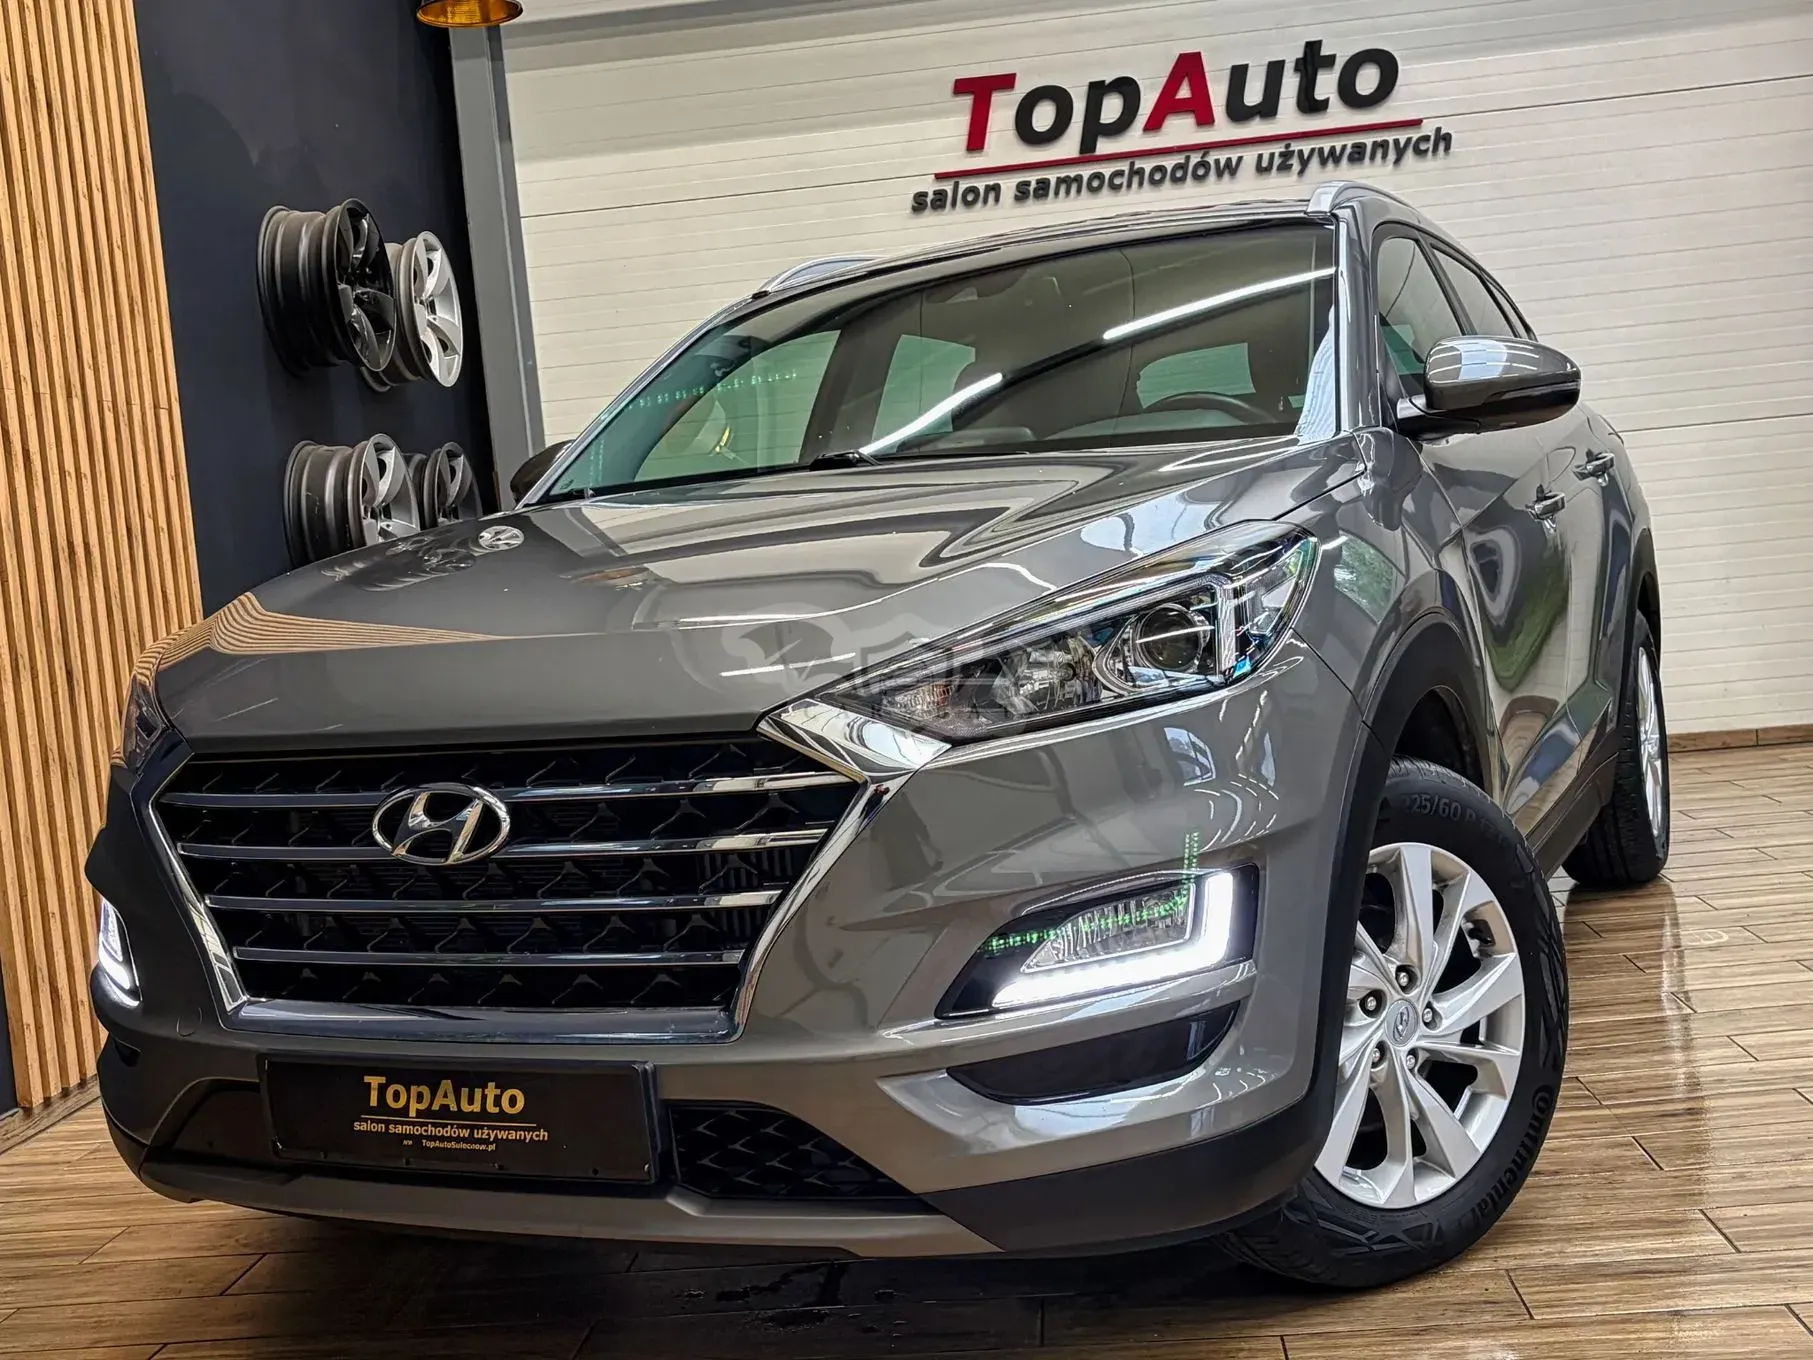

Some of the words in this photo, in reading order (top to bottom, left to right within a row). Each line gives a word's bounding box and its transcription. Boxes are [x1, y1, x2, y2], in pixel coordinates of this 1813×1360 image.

[953, 39, 1400, 155] TopAuto
[912, 180, 1001, 213] salon
[1014, 151, 1244, 202] samochodów
[1256, 126, 1453, 176] używanych
[363, 1075, 526, 1117] TopAuto
[354, 1120, 385, 1132] salon
[389, 1123, 470, 1138] samochodów
[474, 1127, 549, 1143] używanych
